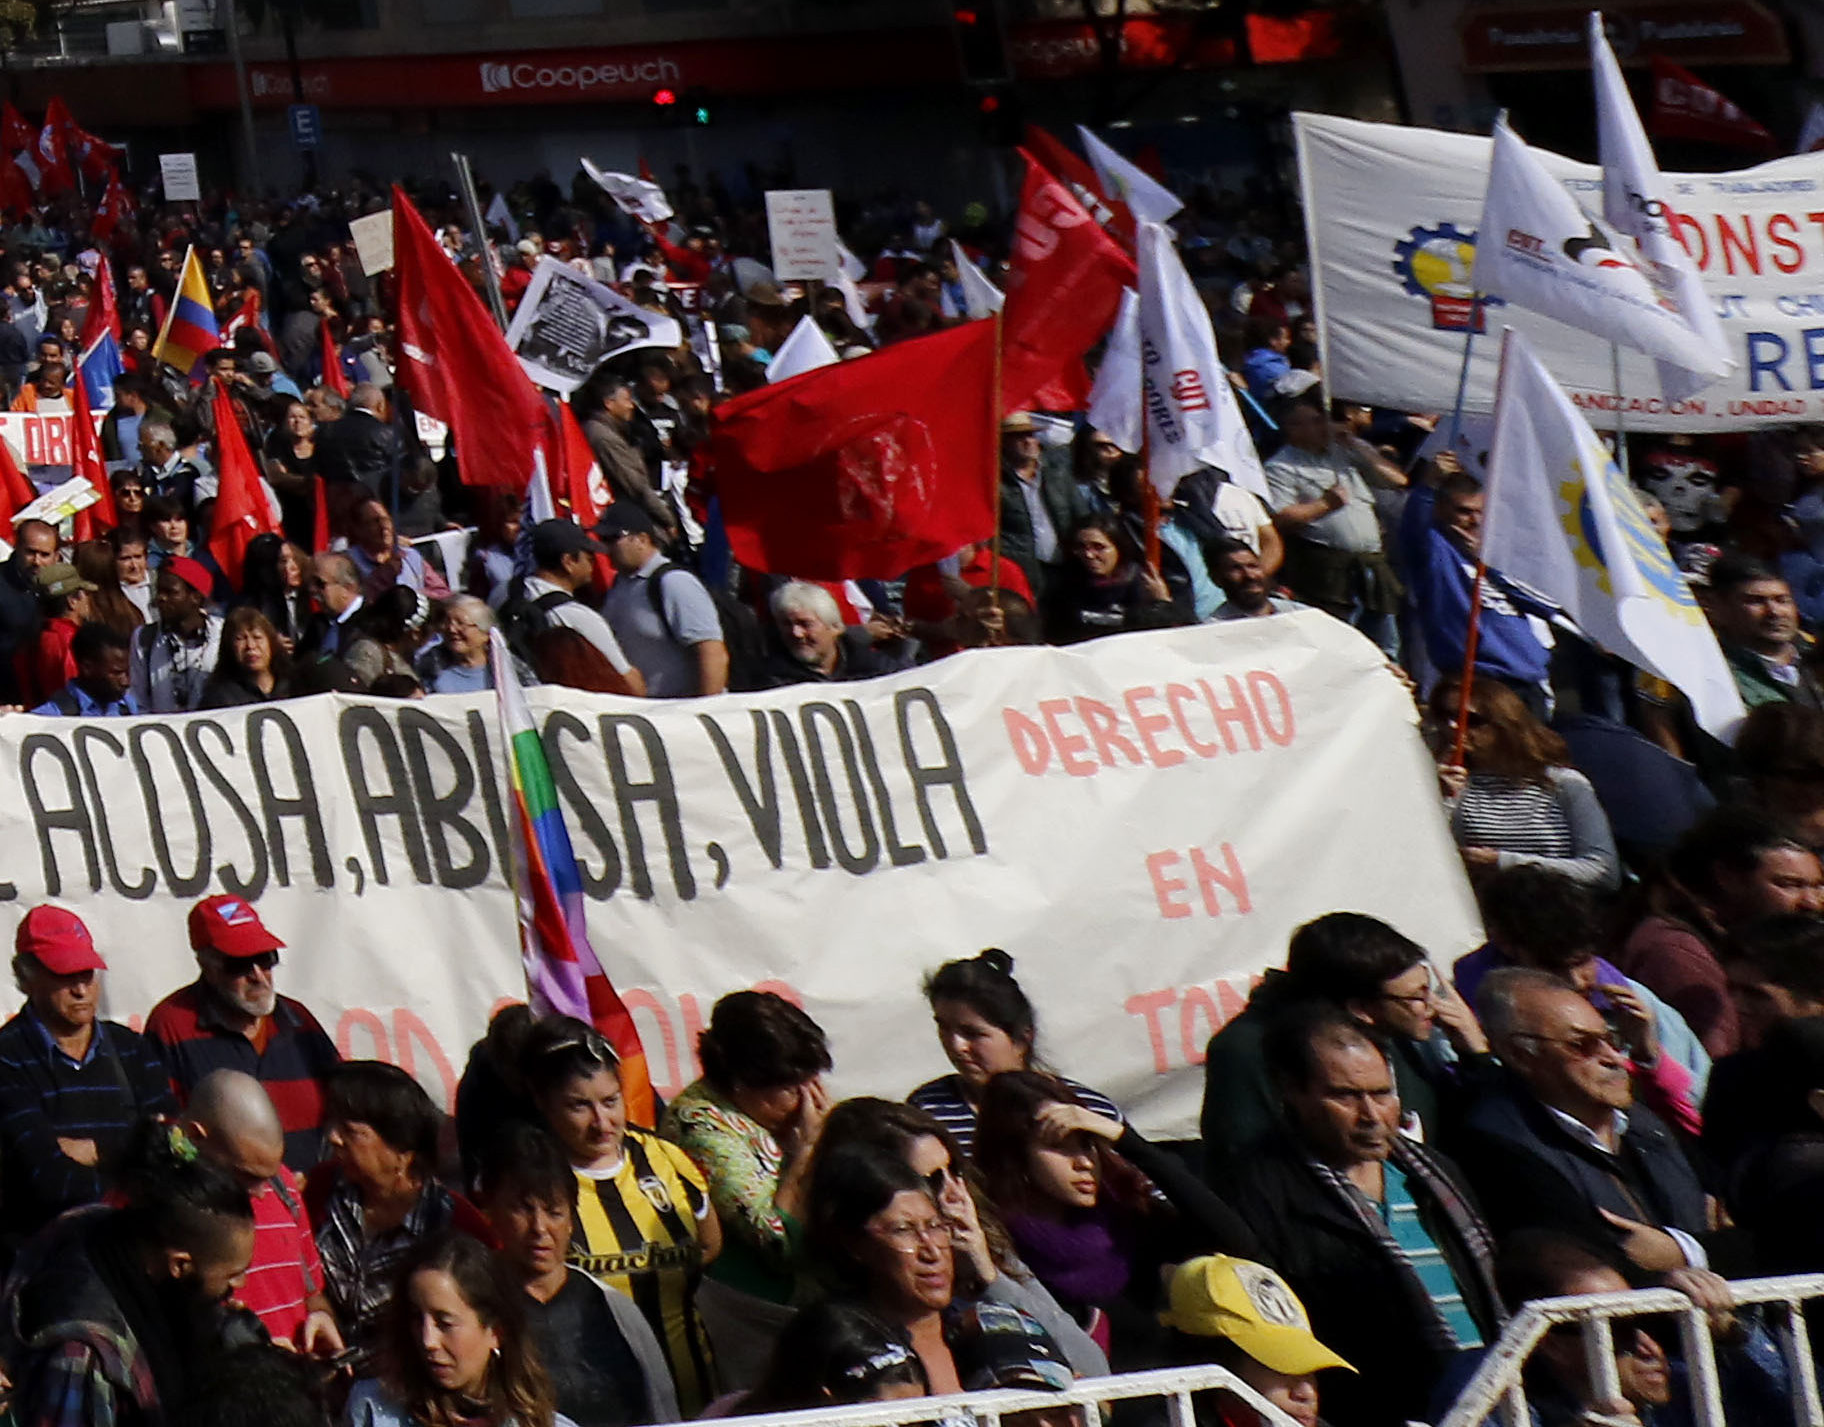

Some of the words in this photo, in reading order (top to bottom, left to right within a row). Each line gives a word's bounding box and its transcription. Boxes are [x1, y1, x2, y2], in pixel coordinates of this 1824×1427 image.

[511, 57, 680, 91] Coopeuch
[1002, 669, 1295, 777] DERECHO
[700, 687, 989, 876] VIOLA
[1144, 842, 1253, 919] EN
